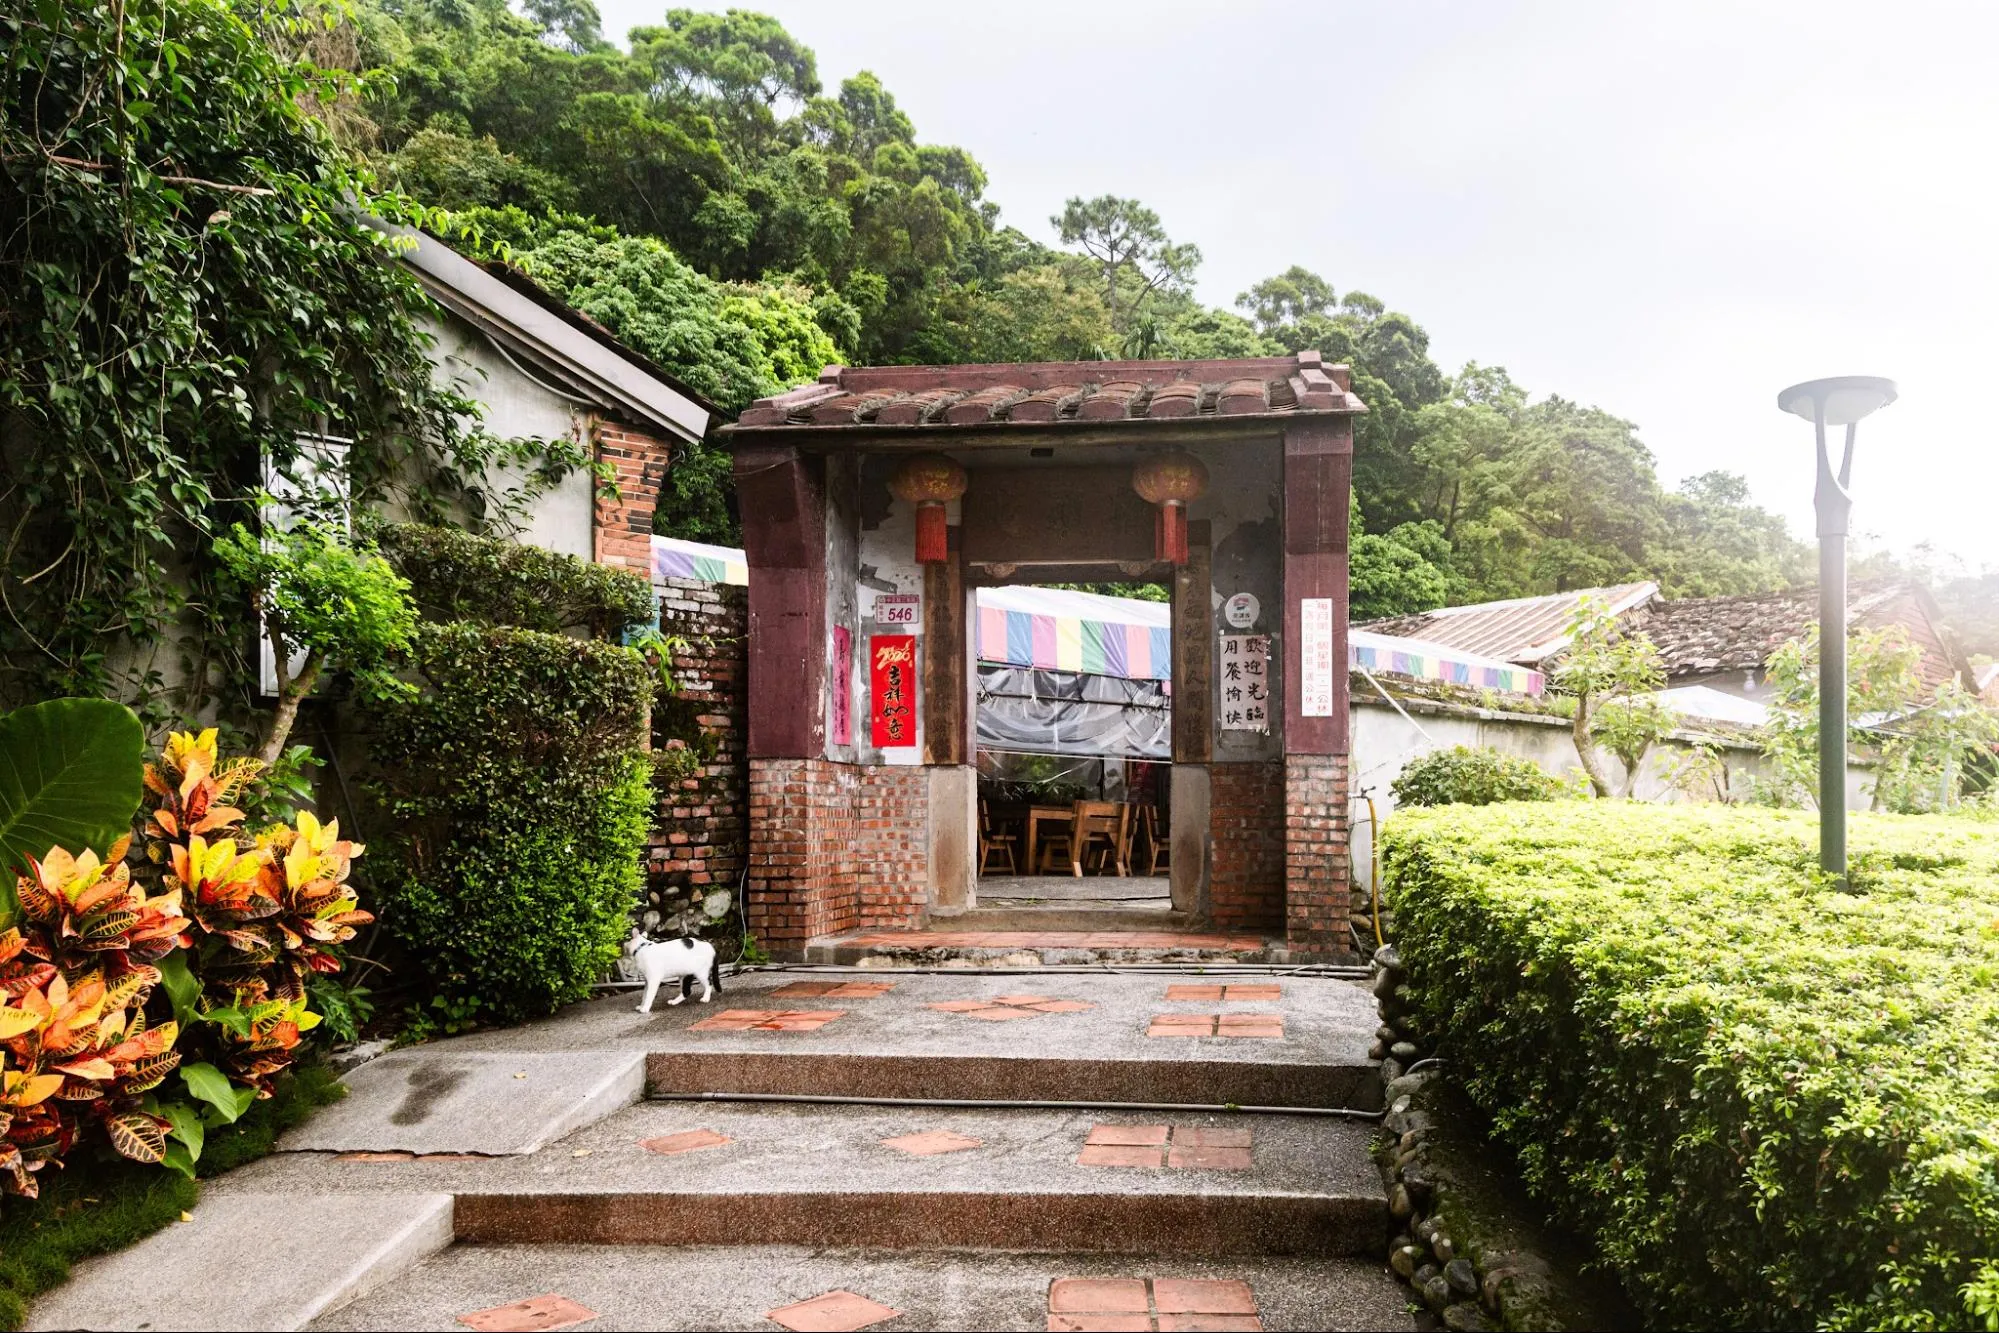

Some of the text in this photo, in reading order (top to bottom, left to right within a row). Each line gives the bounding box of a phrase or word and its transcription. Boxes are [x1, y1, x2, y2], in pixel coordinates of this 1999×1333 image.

[888, 607, 912, 621] 546
[882, 665, 909, 742] 吉祥如意
[1224, 639, 1242, 725] 用餐愉快
[1244, 637, 1265, 721] 歡迎光臨
